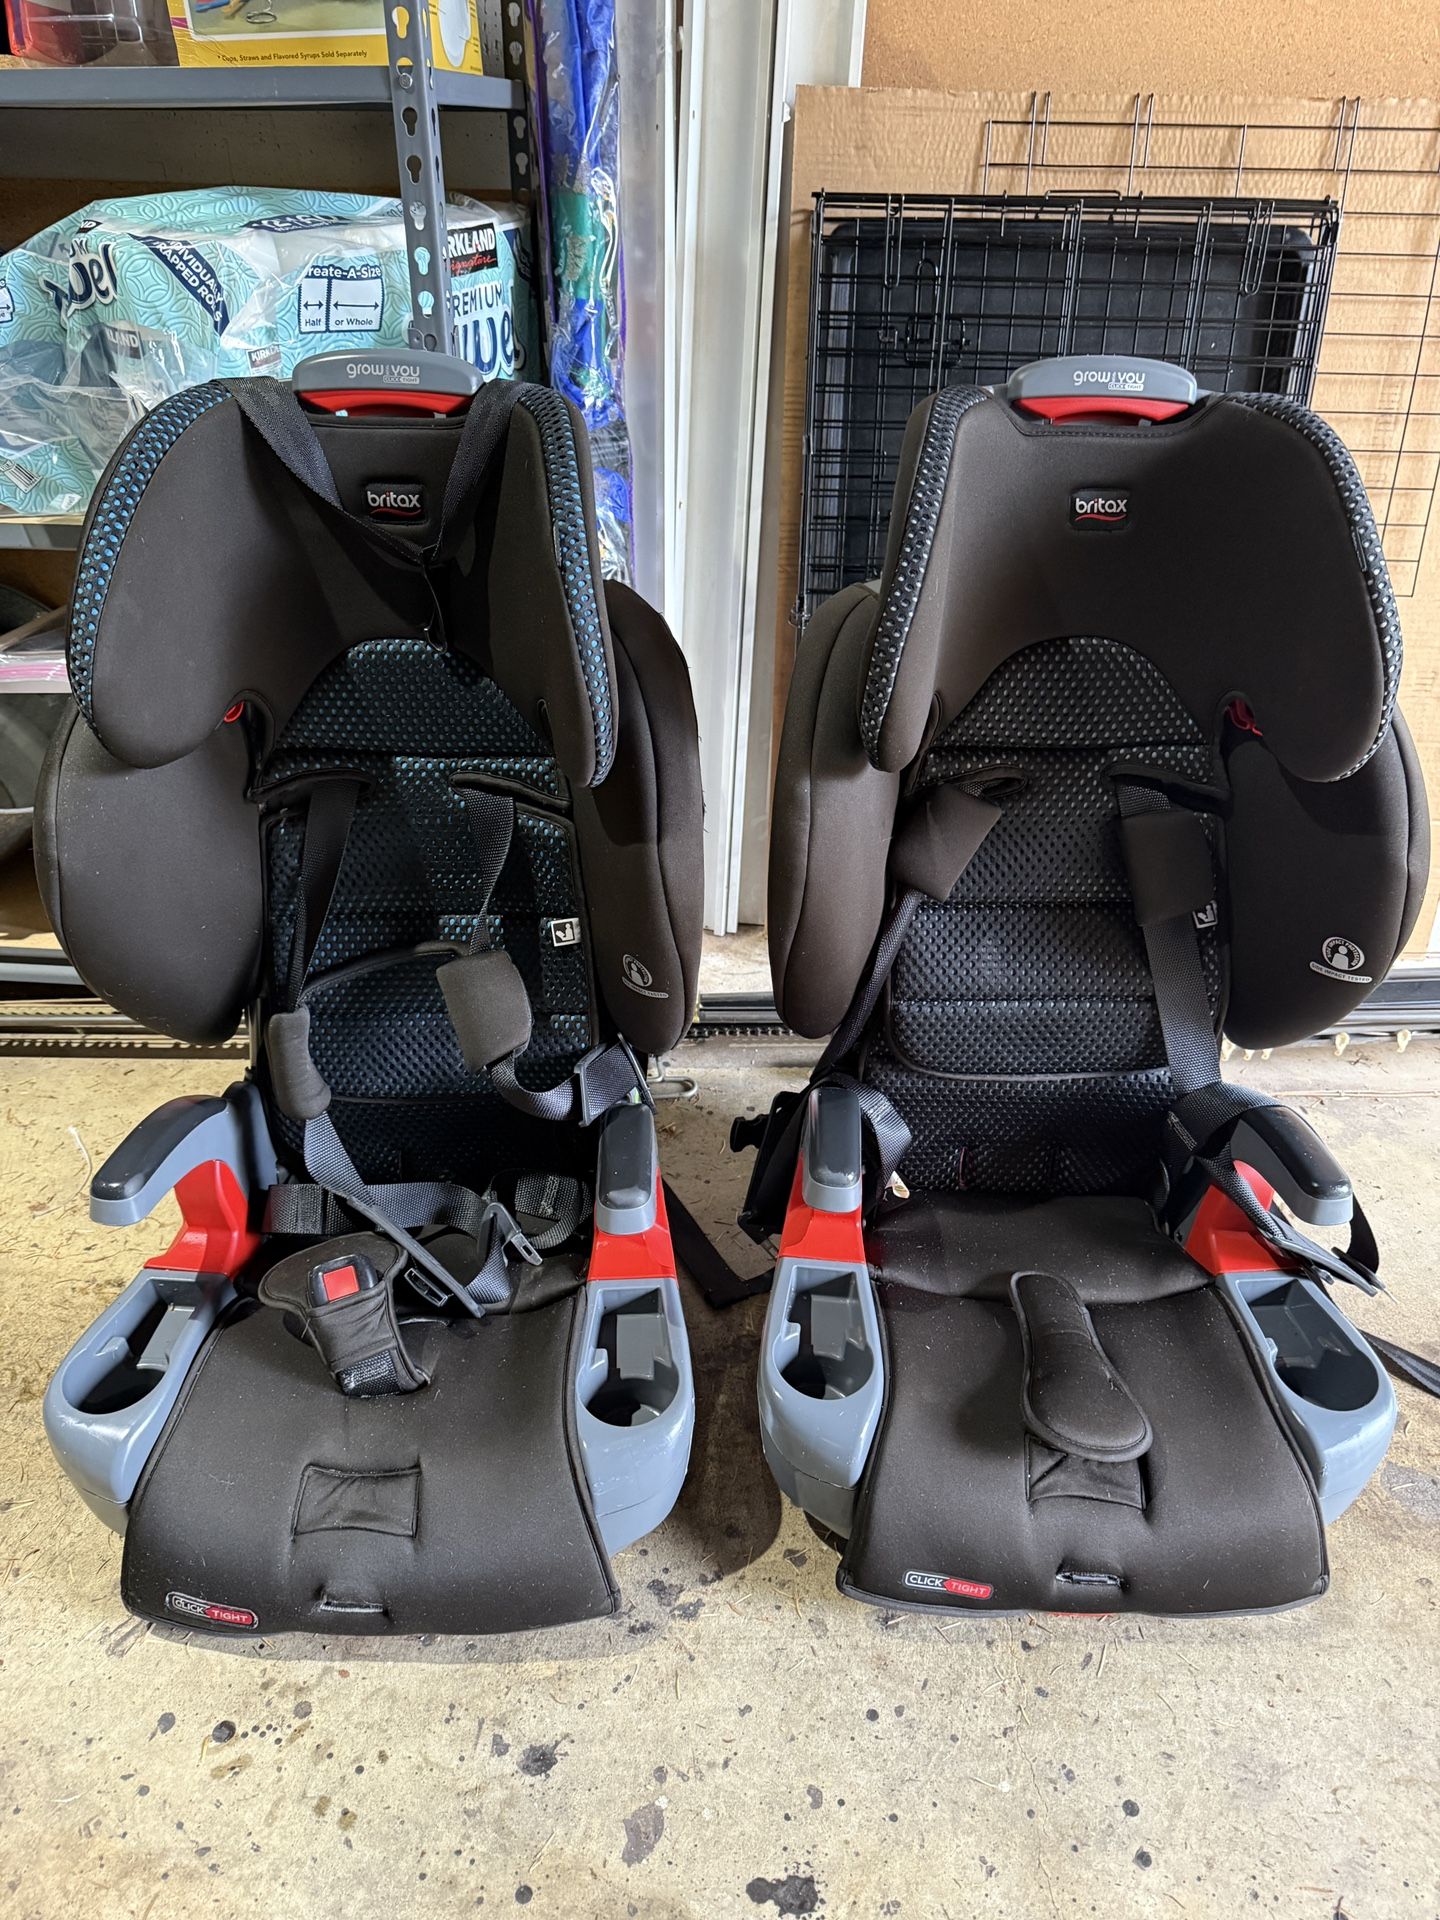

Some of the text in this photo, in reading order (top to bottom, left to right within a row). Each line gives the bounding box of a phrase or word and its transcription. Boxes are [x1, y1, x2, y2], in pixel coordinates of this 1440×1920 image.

[240, 54, 260, 62] Straws
[261, 53, 272, 61] and
[273, 52, 299, 61] Flavored
[300, 51, 321, 60] Syrups
[321, 50, 335, 58] Sold
[336, 49, 368, 58] Separately
[305, 265, 382, 279] reate-A-Size
[450, 253, 497, 275] ignature
[304, 318, 321, 327] Half
[346, 318, 374, 326] Whole
[346, 363, 384, 379] grow
[391, 364, 420, 377] you
[1073, 370, 1111, 386] grow
[1117, 371, 1146, 384] you
[367, 490, 421, 507] britax
[1075, 497, 1128, 513] britax
[909, 1575, 987, 1595] CLICK TIGHT
[174, 1598, 248, 1622] CLICK TIGHT
